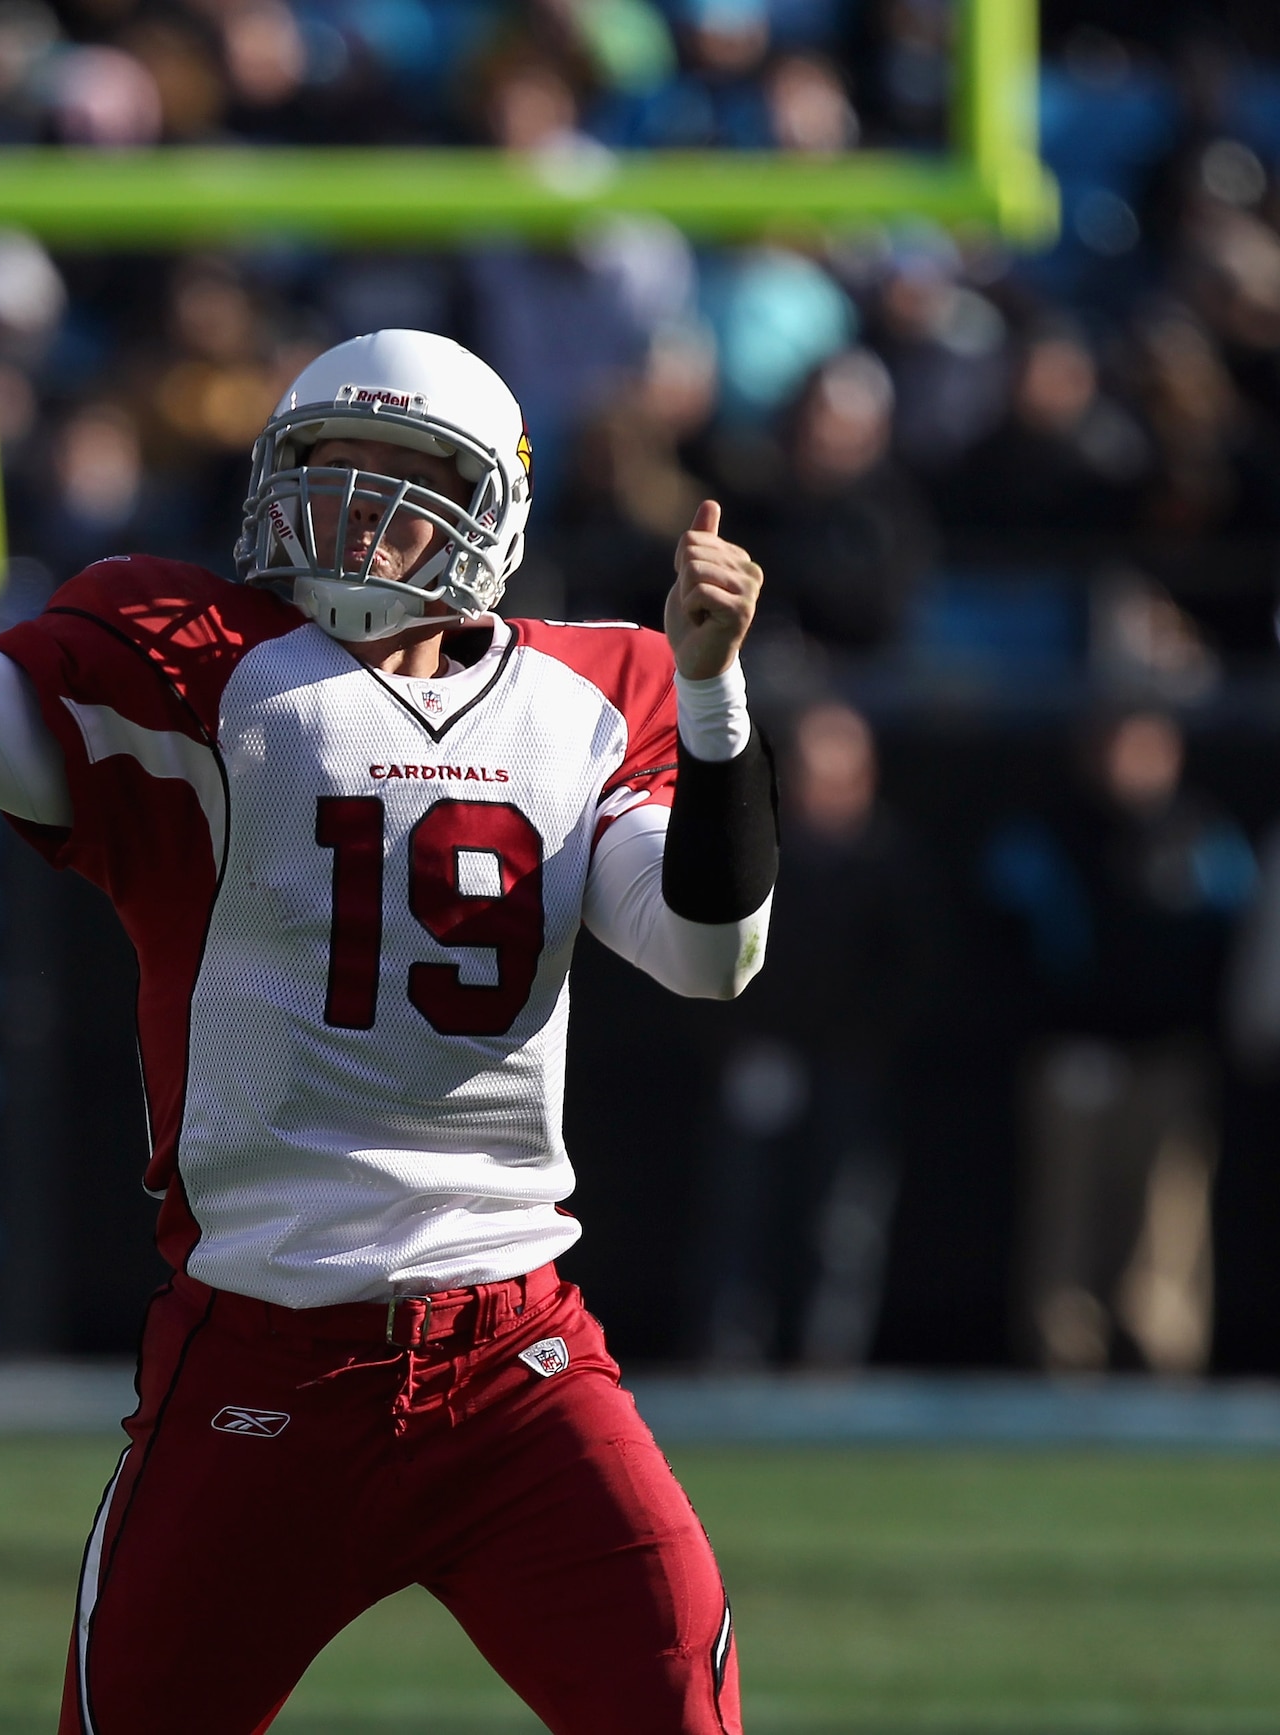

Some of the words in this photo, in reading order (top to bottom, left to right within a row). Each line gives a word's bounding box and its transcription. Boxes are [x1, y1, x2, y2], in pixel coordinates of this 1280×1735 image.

[357, 390, 410, 411] Riddell
[370, 764, 509, 782] CARDINALS
[315, 795, 544, 1036] 19
